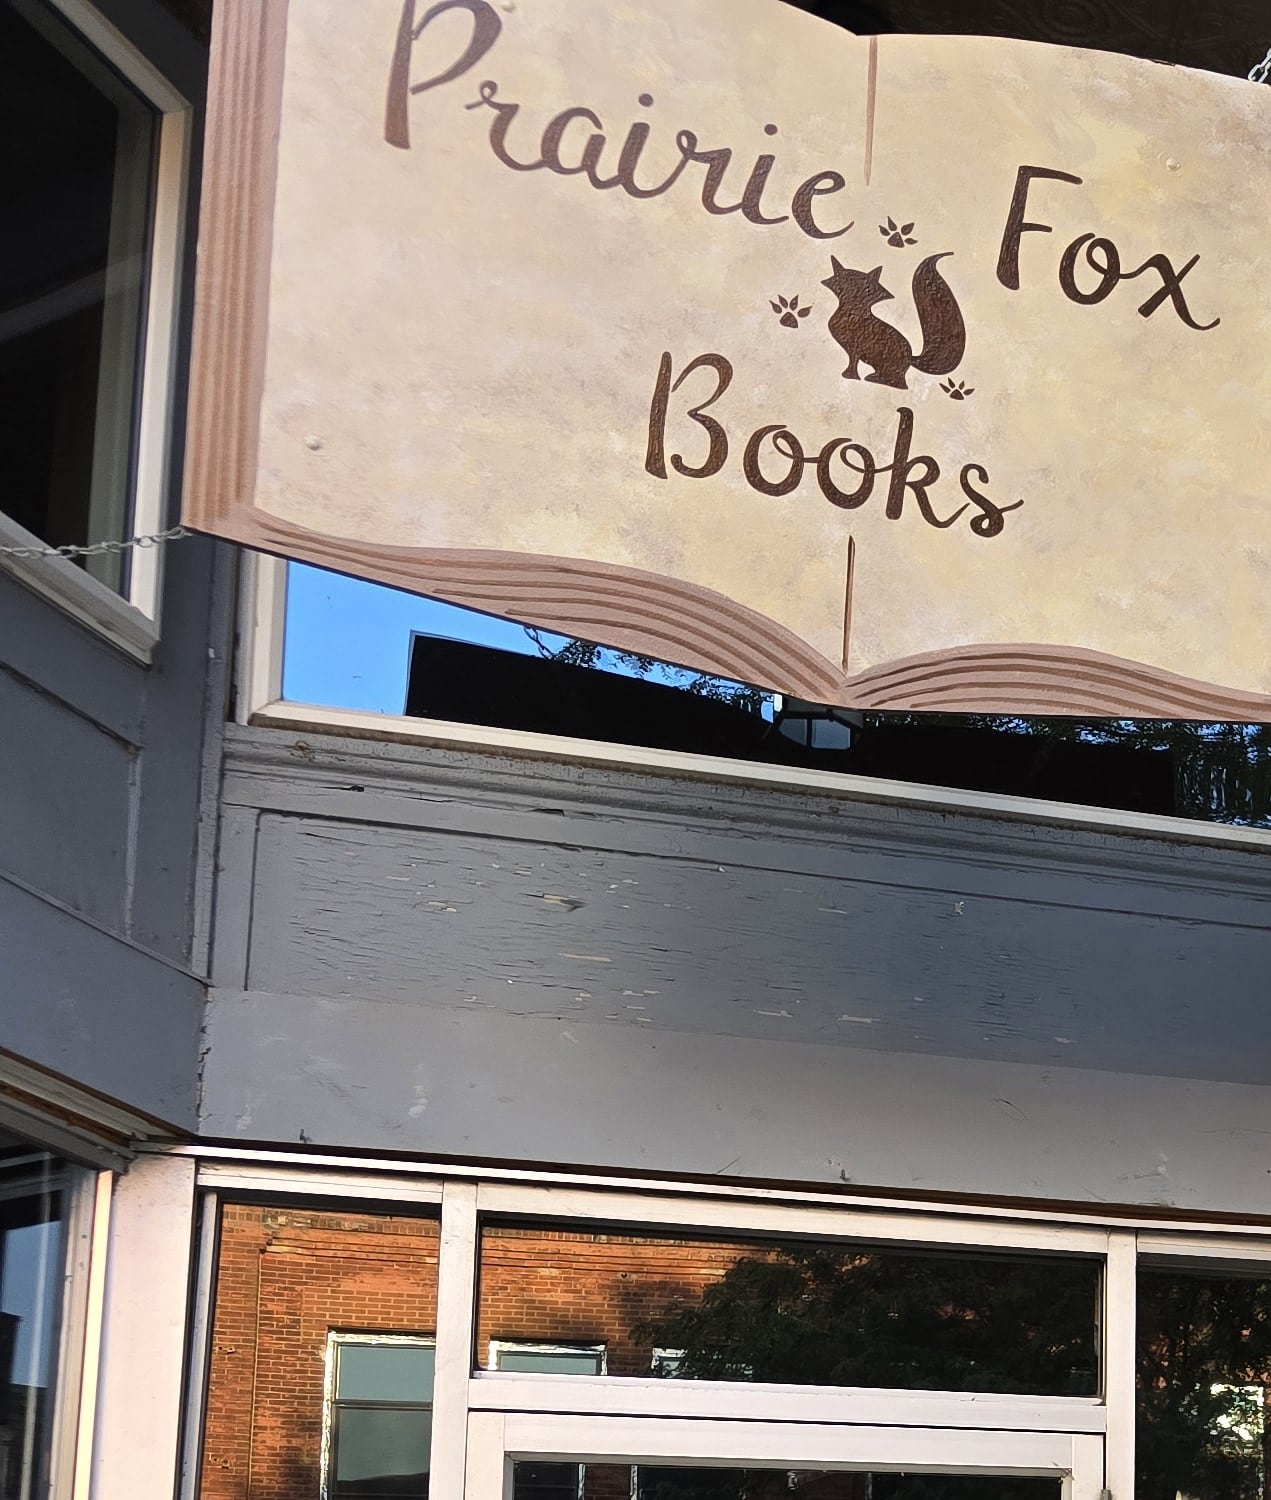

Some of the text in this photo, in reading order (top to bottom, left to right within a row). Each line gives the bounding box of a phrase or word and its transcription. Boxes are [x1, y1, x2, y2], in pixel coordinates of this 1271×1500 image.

[385, 0, 854, 240] Prairie
[996, 166, 1220, 331] Fox
[644, 351, 1024, 538] Books
